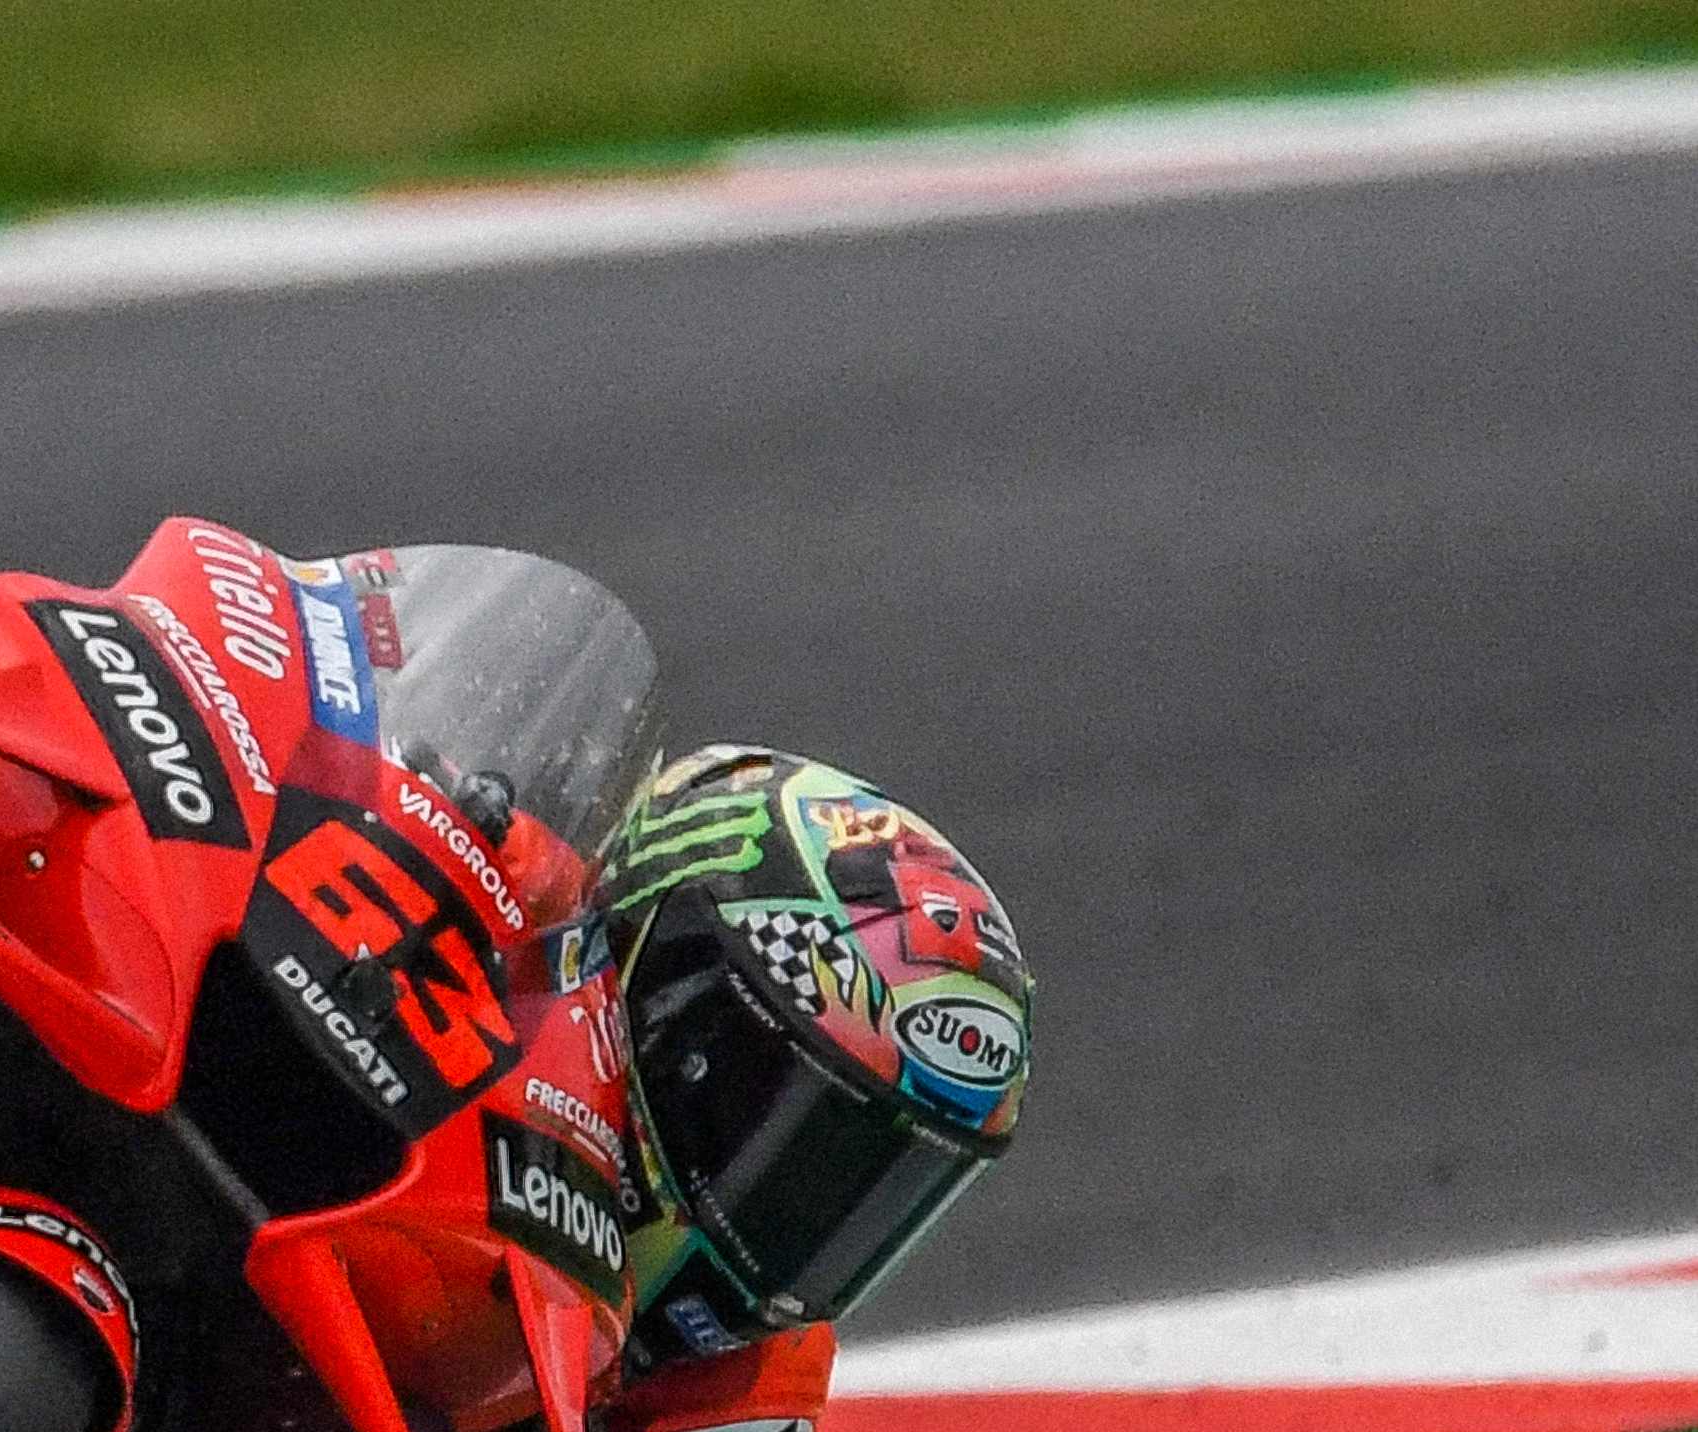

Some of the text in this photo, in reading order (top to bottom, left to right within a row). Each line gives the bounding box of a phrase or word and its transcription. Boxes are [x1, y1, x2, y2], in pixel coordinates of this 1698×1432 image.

[58, 607, 215, 826] Lenovo
[265, 819, 515, 1088] 63
[273, 954, 408, 1106] DUCATI
[498, 1137, 624, 1272] Lenovo
